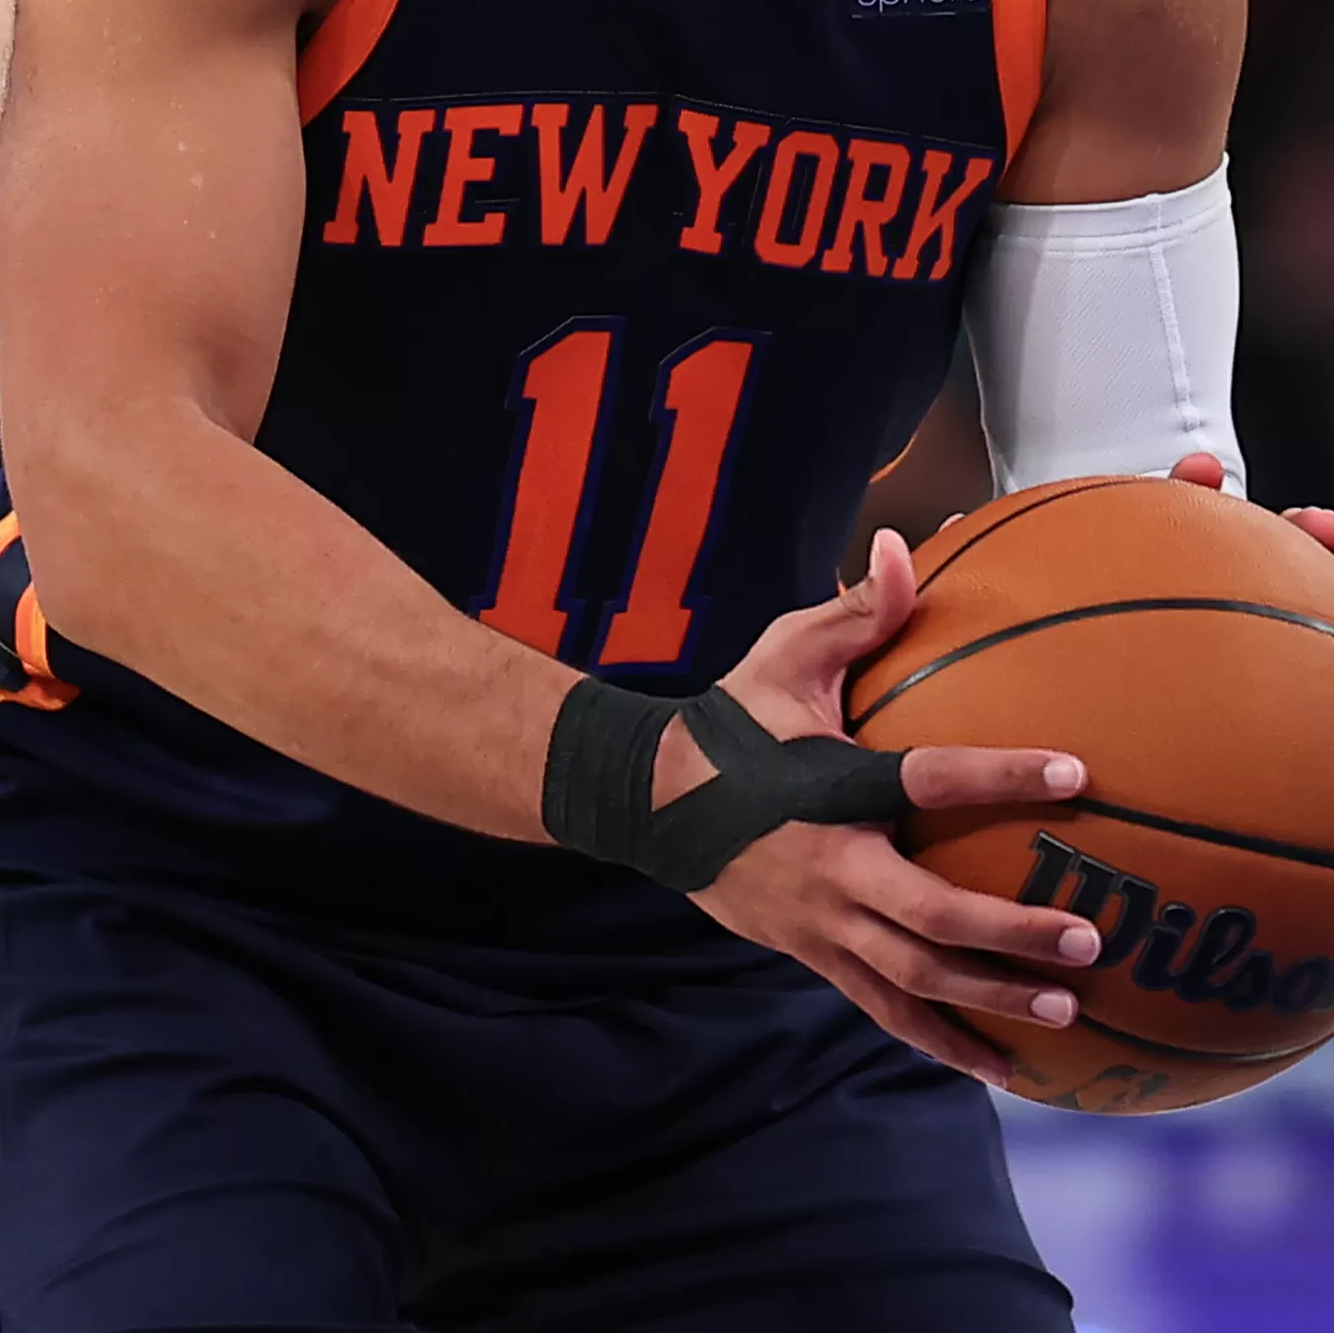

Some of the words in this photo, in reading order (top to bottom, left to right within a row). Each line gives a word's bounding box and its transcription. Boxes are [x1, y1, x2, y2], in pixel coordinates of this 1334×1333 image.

[322, 103, 659, 248] NEW
[677, 110, 993, 282] YORK
[475, 320, 767, 668] 11
